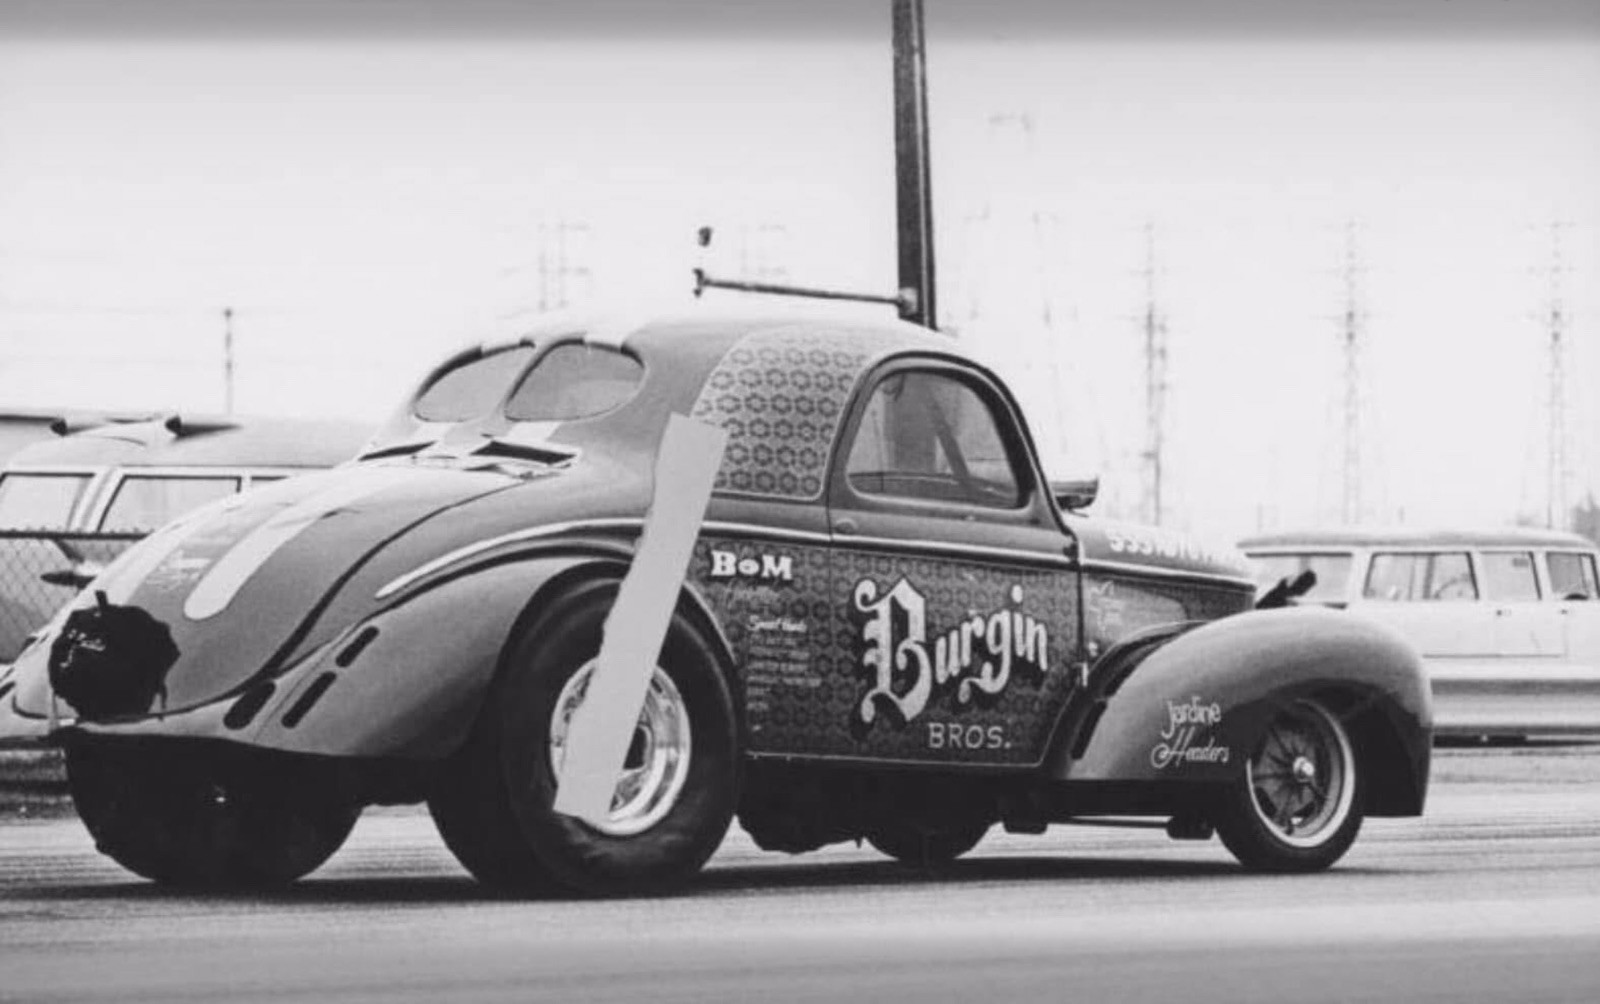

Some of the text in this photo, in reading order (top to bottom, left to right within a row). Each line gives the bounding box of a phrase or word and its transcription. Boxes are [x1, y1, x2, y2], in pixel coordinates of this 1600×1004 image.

[854, 577, 1048, 723] Burgin
[928, 722, 1012, 749] BROS.
[1161, 695, 1222, 739] Jardine
[1150, 725, 1230, 769] Headers
